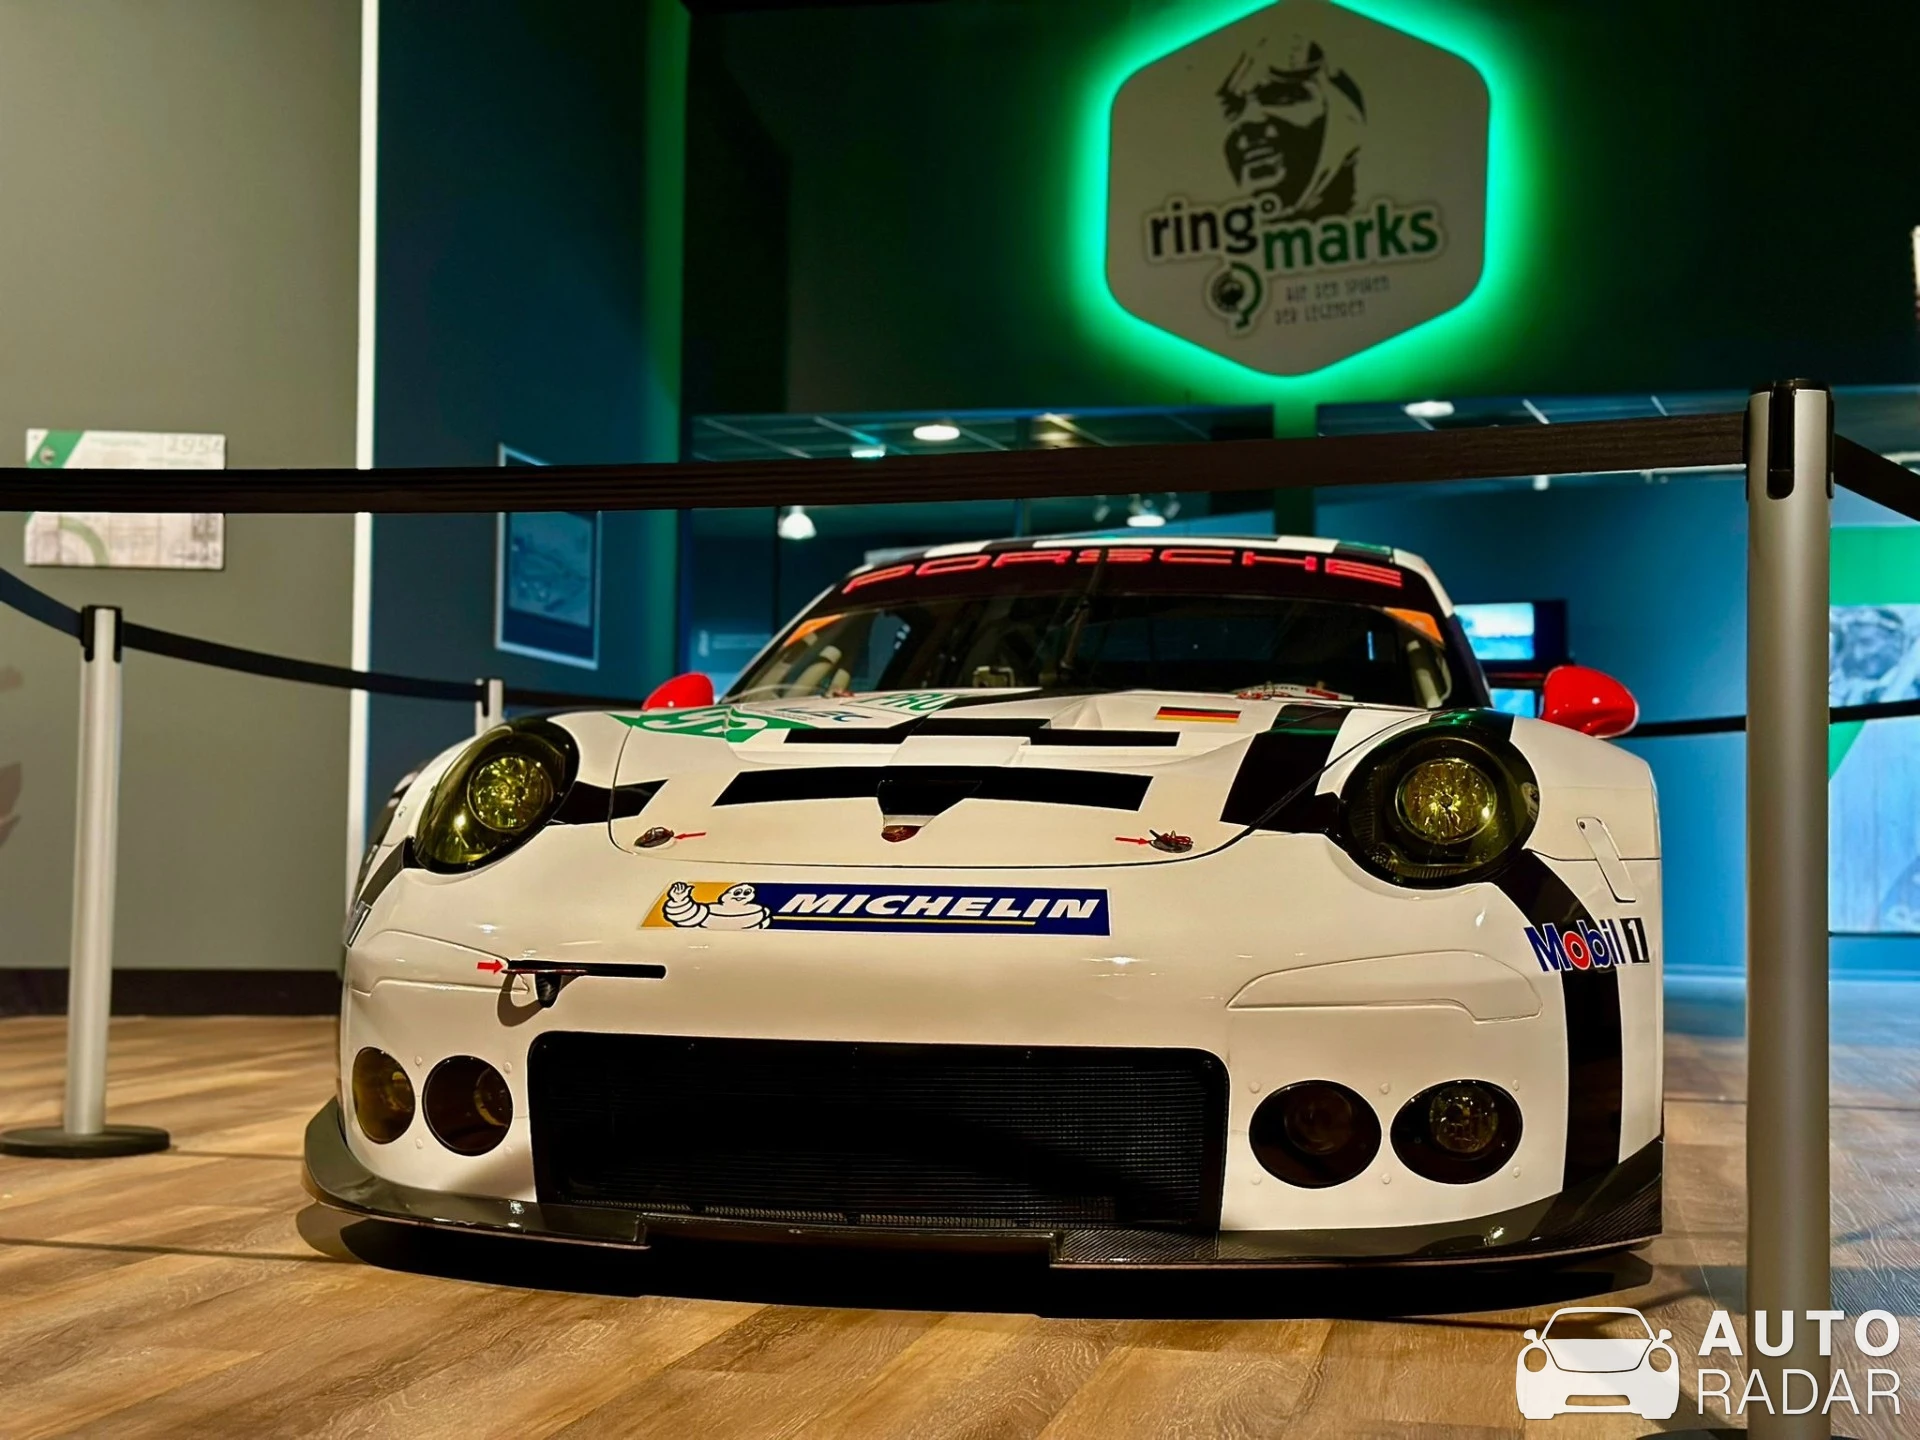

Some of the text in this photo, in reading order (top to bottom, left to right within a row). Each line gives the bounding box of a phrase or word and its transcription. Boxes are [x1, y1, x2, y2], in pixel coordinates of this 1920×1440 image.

[1263, 204, 1438, 271] marks
[842, 547, 1403, 594] PORSCHE
[778, 892, 1100, 920] MICHELIN
[1524, 918, 1649, 972] Mobil 1
